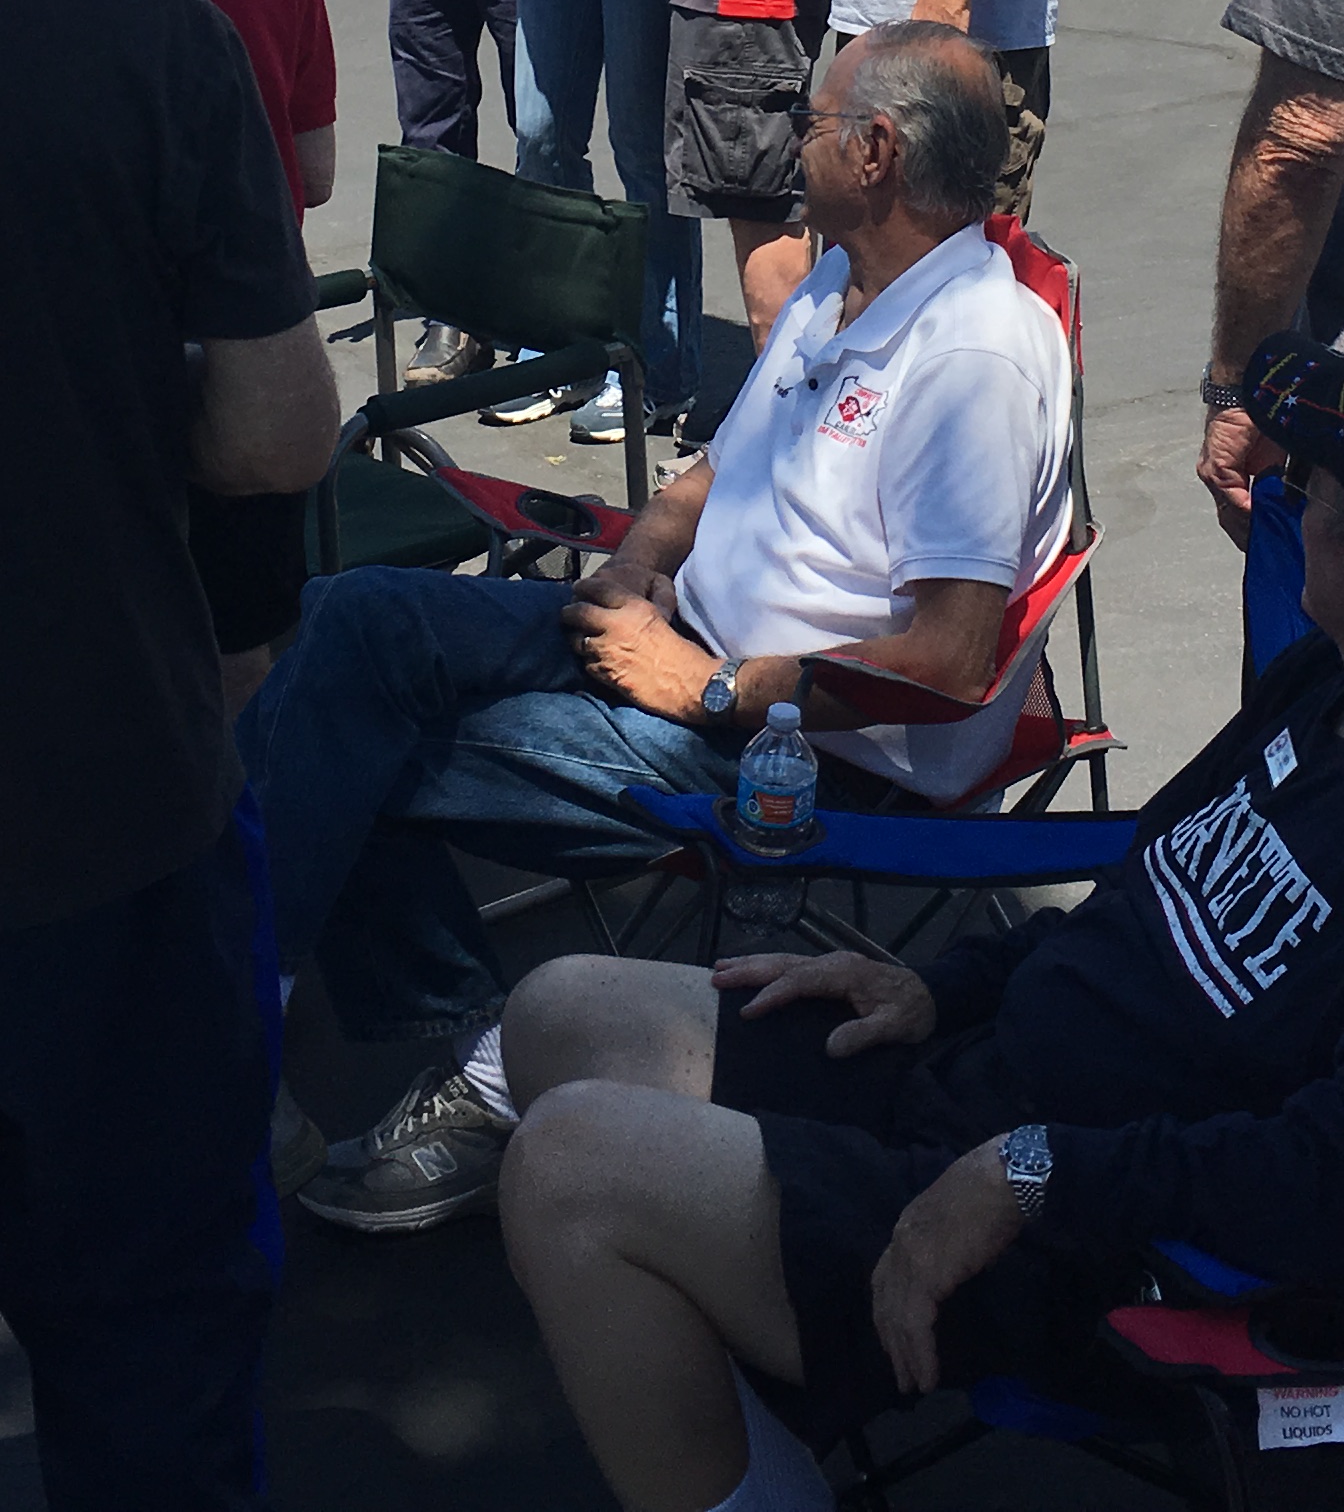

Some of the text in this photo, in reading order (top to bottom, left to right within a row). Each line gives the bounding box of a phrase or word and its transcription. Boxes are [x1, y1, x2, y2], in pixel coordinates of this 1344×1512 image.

[1274, 1385, 1340, 1399] WARNING
[1280, 1405, 1331, 1418] NO HOT
[1282, 1424, 1333, 1440] LIQUIDS
